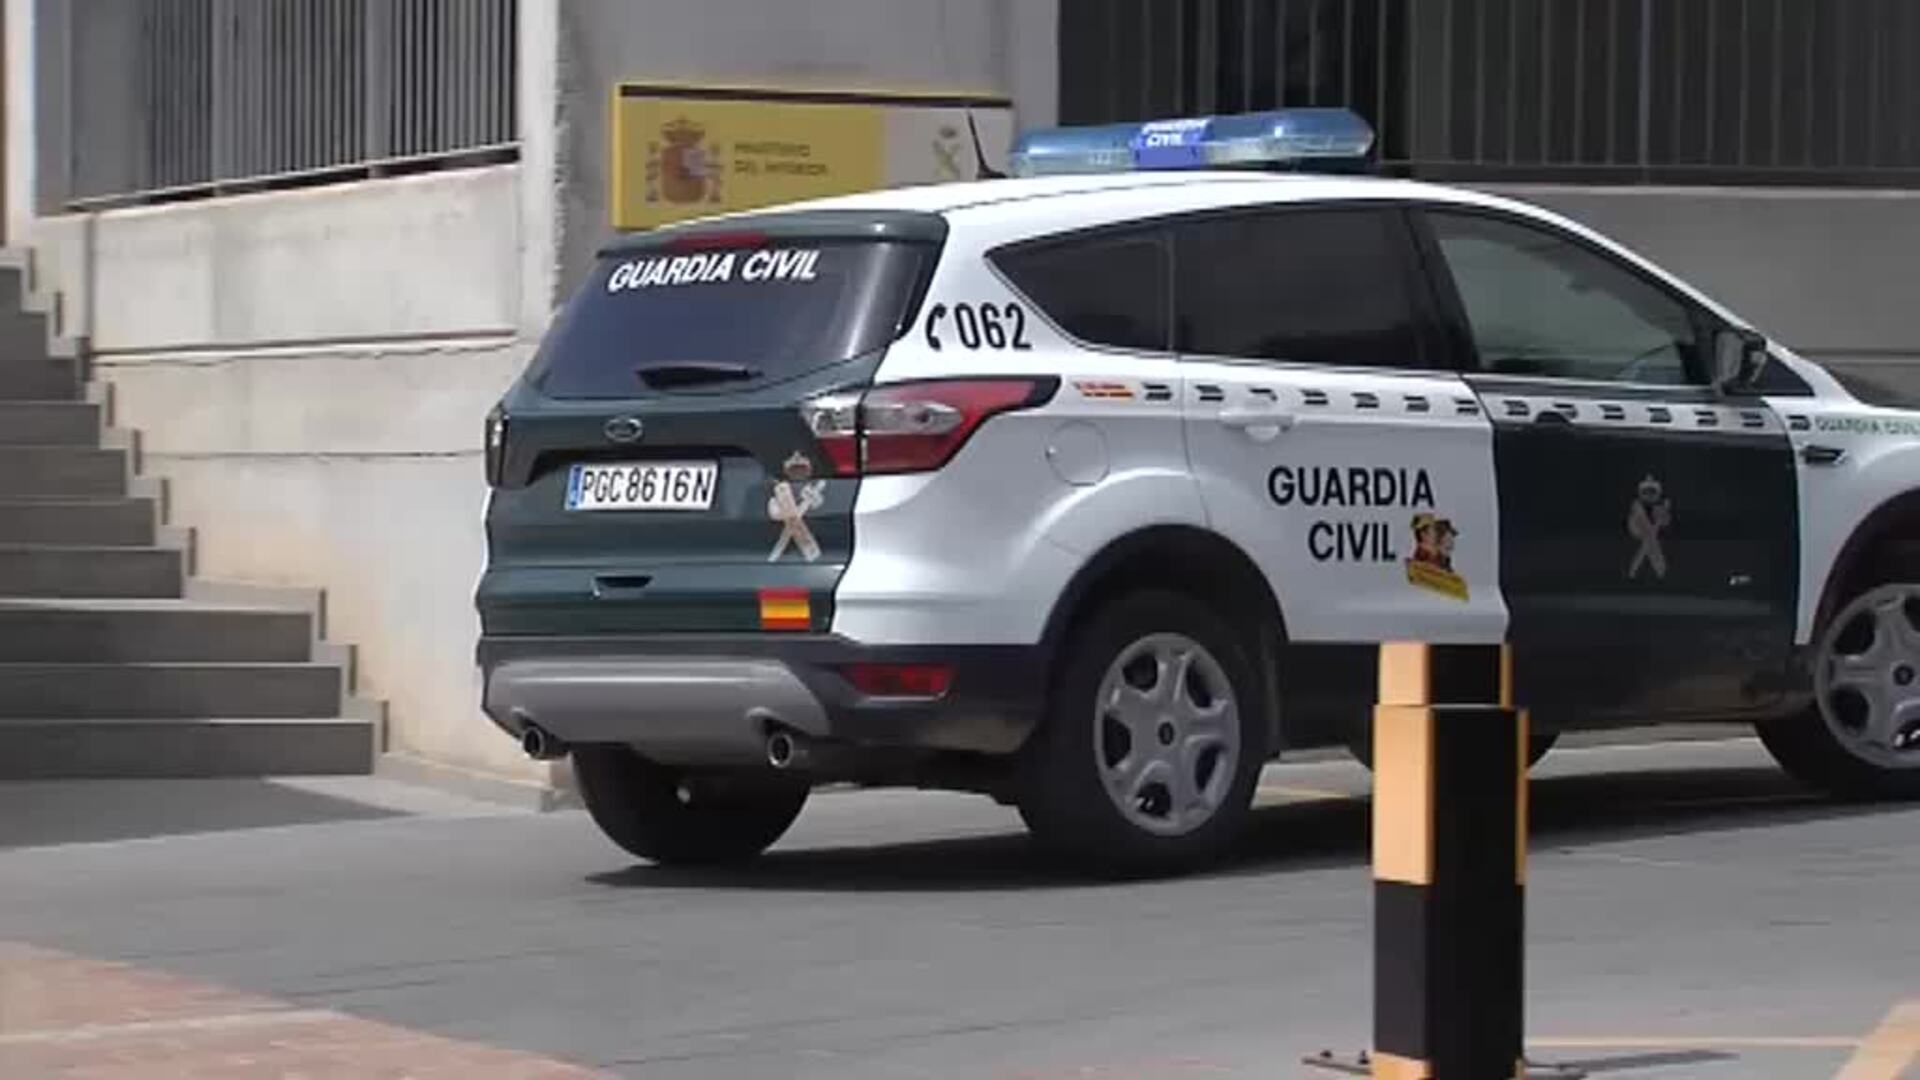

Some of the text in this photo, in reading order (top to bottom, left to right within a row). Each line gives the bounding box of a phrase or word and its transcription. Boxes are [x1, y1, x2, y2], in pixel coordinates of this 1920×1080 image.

[608, 250, 819, 292] GUARDIA CIVIL
[954, 303, 1032, 350] 062
[584, 467, 712, 502] PGC8616N
[1268, 466, 1435, 508] GUARDIA
[1308, 522, 1396, 561] CIVIL
